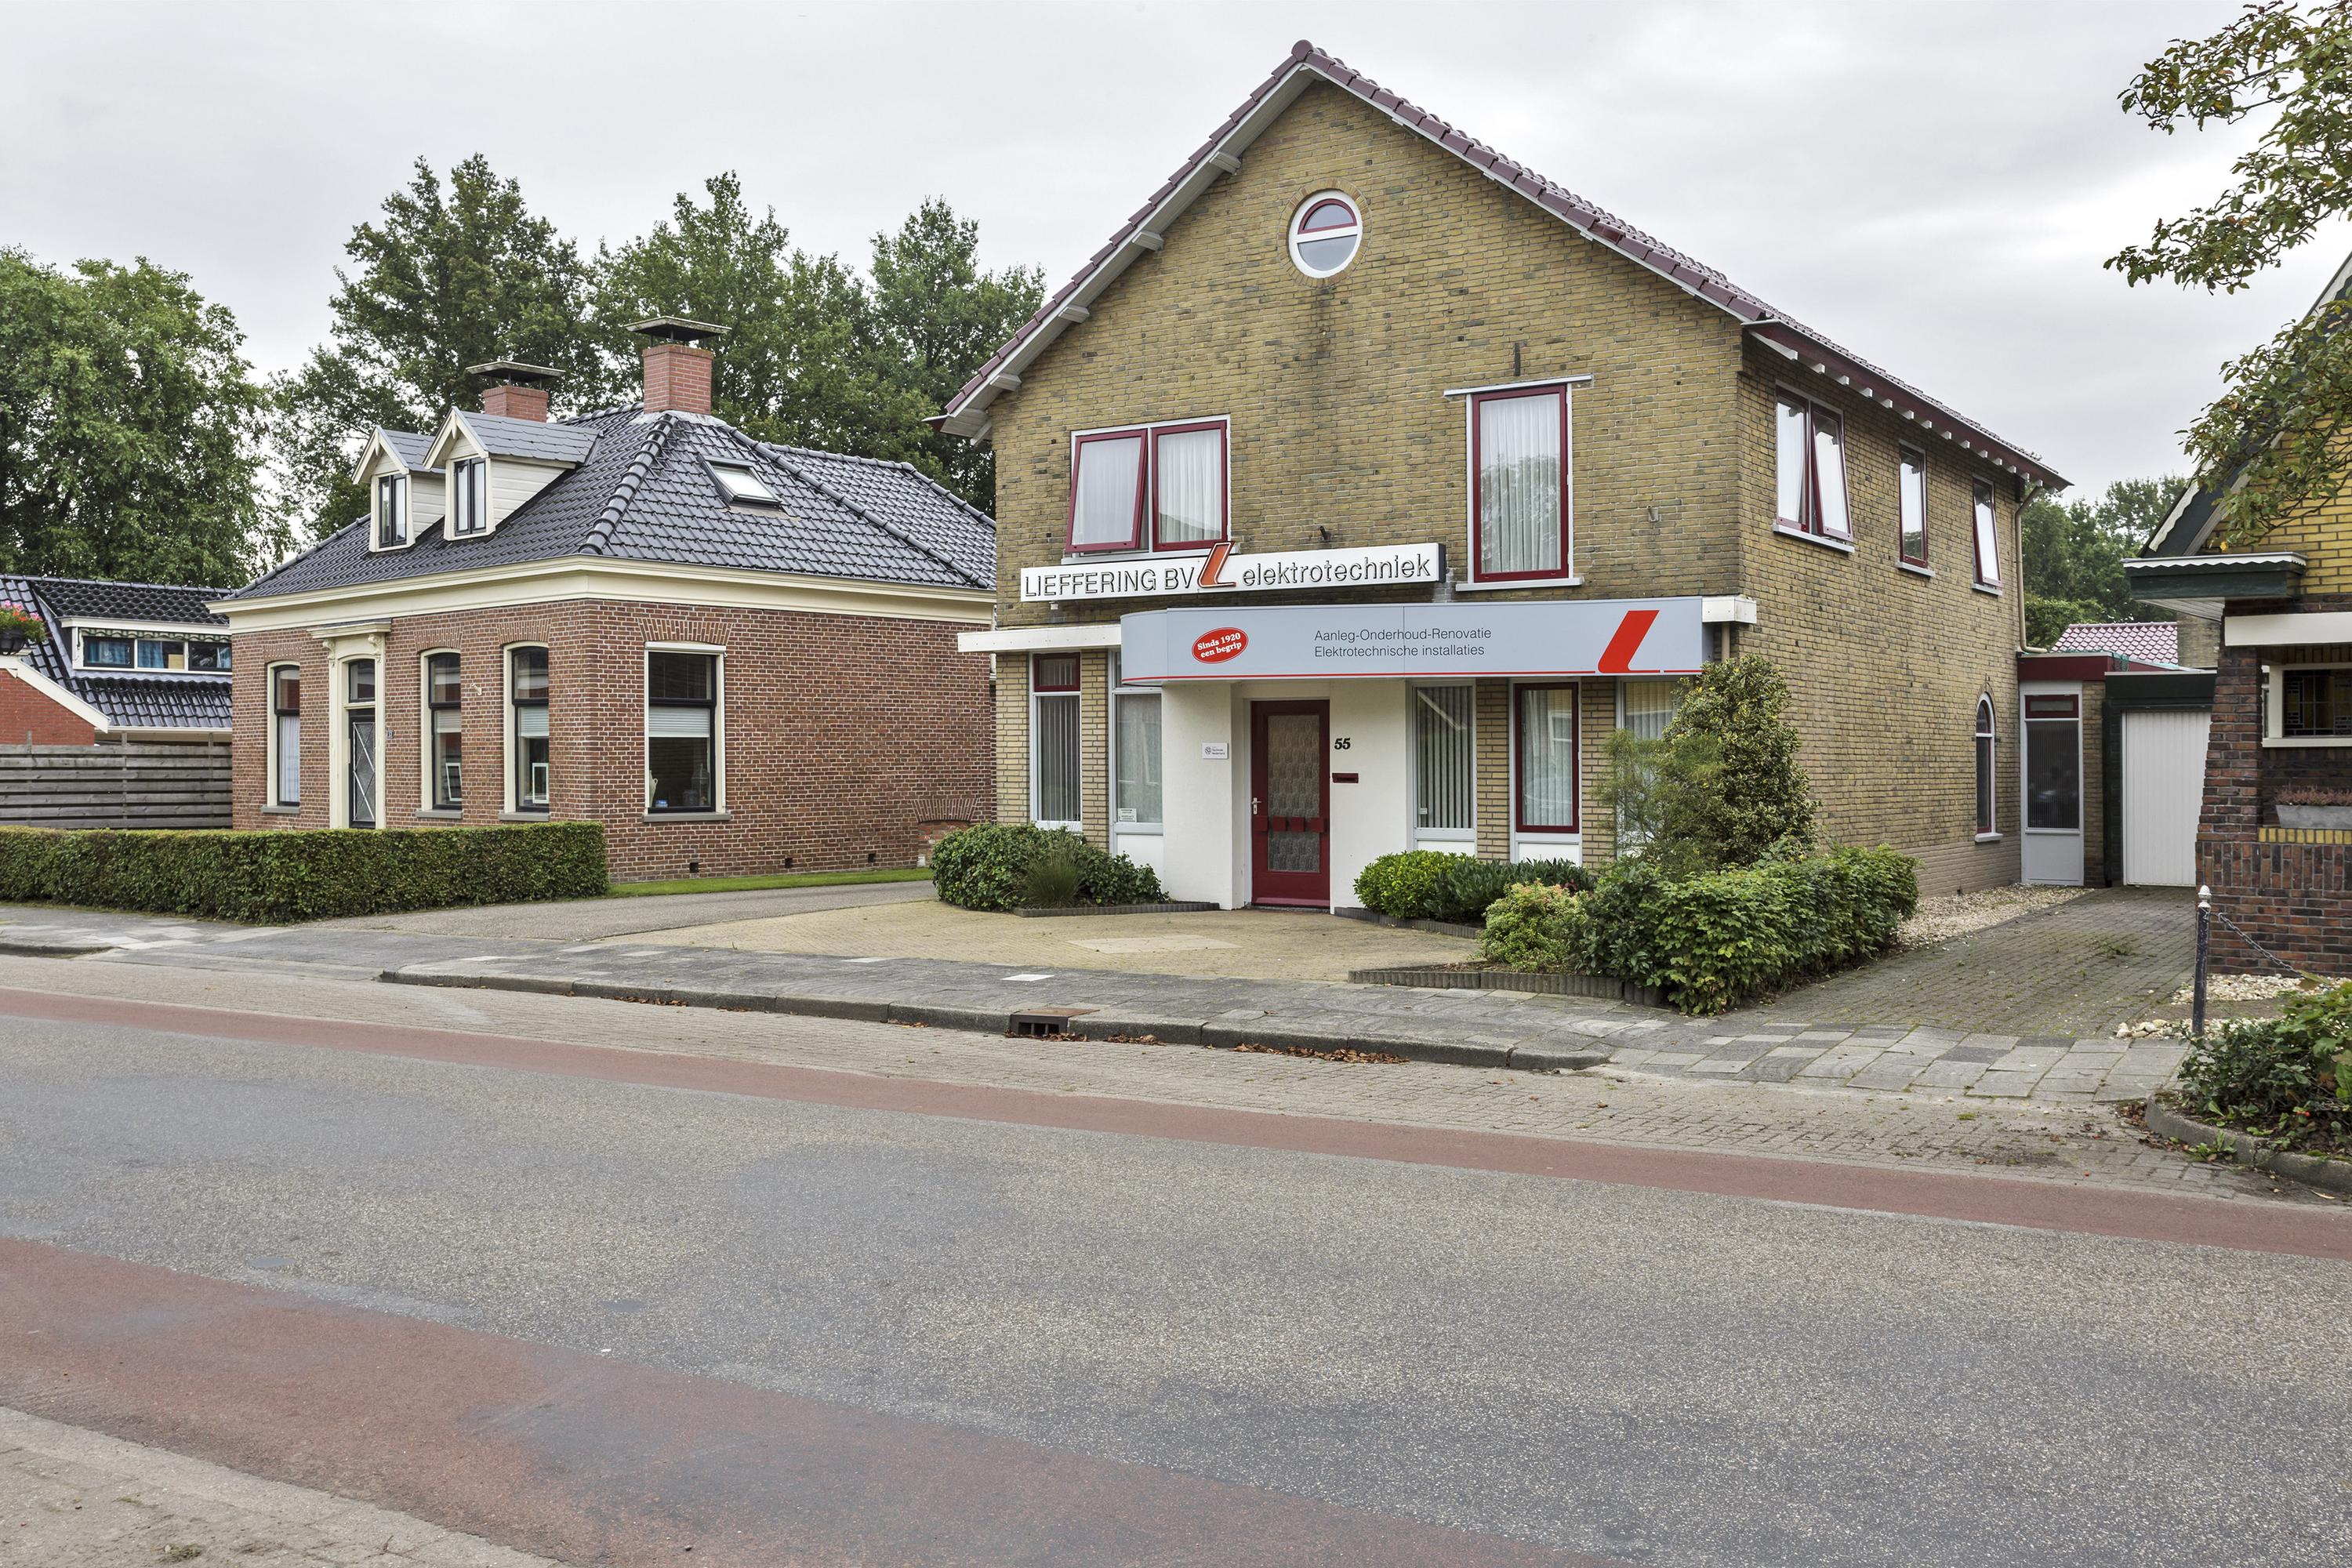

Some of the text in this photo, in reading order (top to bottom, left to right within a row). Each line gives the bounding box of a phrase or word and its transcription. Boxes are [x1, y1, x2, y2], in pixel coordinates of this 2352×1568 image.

[1025, 568, 1156, 597] LIEFFERING
[1164, 566, 1196, 590] BV
[1243, 554, 1431, 586] elektrotechniek
[1197, 632, 1241, 651] Sinds 1920
[1314, 628, 1492, 643] Aanleg-Onderhoud-Renovatie
[1200, 642, 1242, 658] een begrip
[1315, 644, 1485, 658] Elektrotechnische installaties
[1334, 737, 1351, 750] 55
